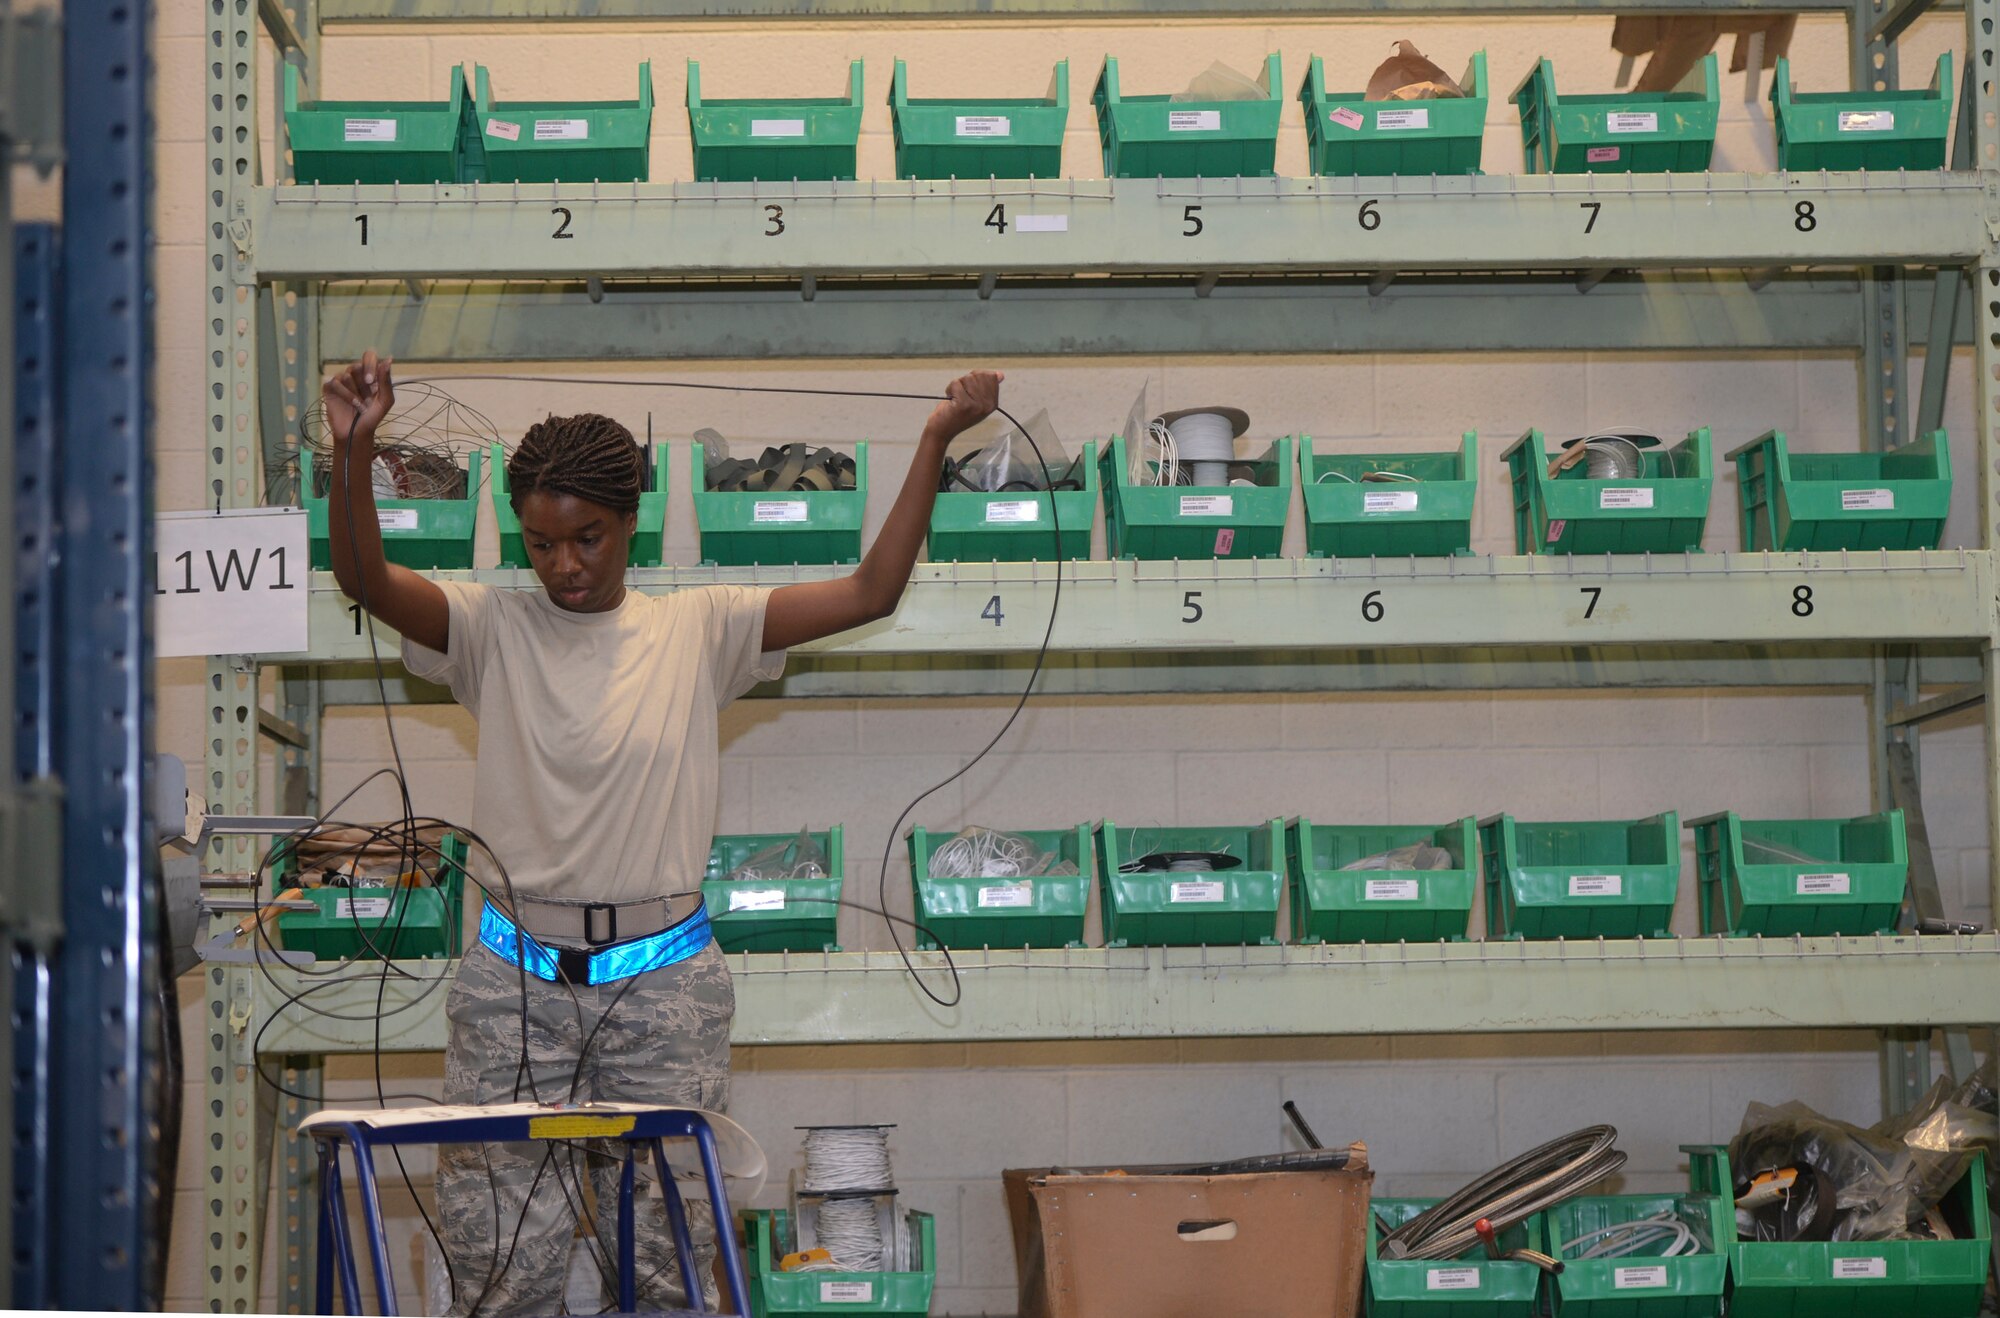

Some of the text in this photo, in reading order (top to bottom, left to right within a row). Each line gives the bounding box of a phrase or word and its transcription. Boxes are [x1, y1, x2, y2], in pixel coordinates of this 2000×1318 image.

[354, 214, 367, 246] 1
[551, 207, 574, 239] 2
[764, 204, 786, 236] 3
[984, 203, 1008, 234] 4
[1182, 205, 1203, 237] 5
[1358, 199, 1381, 231] 6
[1580, 202, 1602, 234] 7
[1794, 200, 1817, 233] 8
[980, 595, 1005, 627] 4
[1181, 591, 1203, 624] 5
[1361, 590, 1385, 623] 6
[1580, 587, 1602, 619] 7
[1791, 585, 1814, 618] 8
[348, 604, 362, 636] 1
